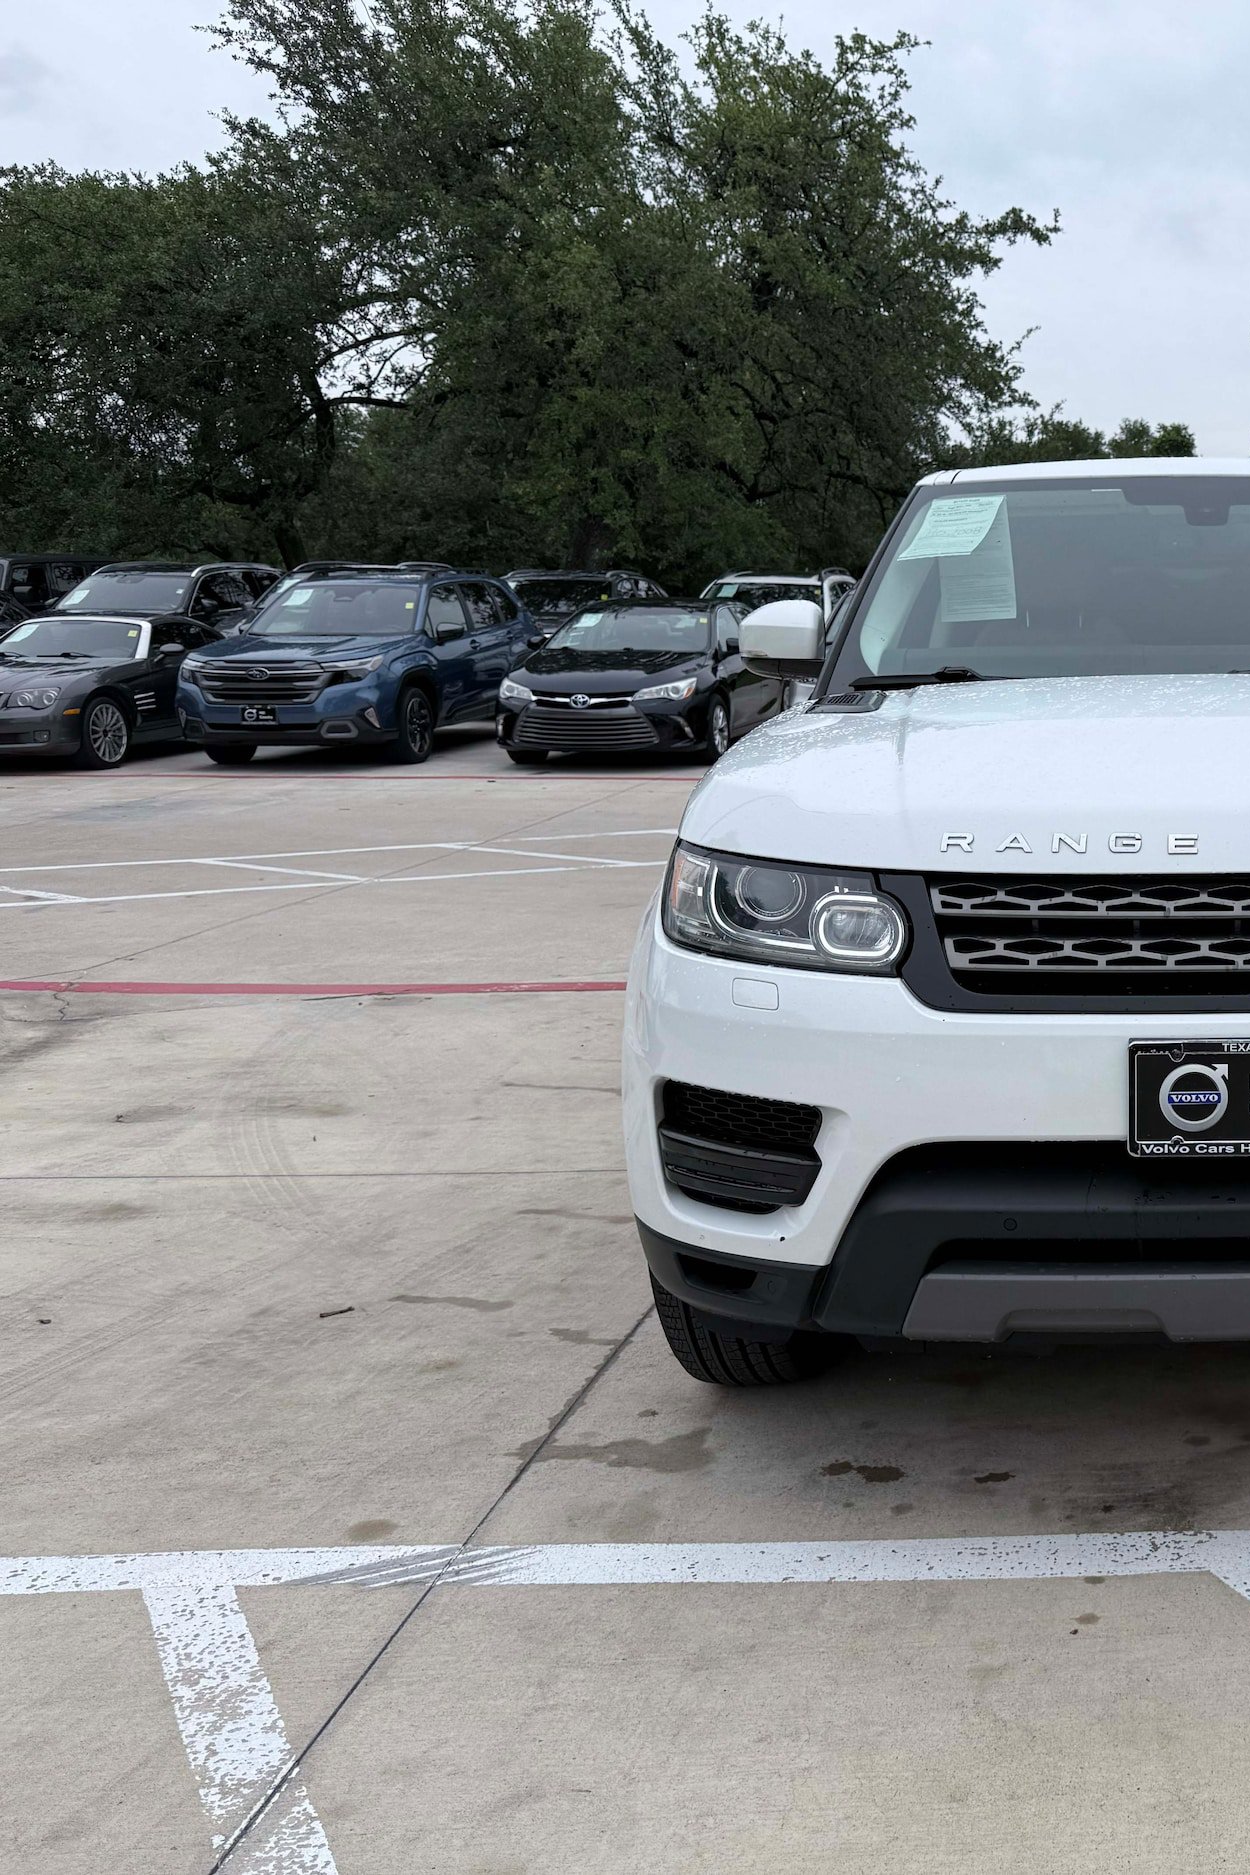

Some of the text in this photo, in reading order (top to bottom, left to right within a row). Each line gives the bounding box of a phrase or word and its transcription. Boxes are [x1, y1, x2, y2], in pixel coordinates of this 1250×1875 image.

[939, 831, 1200, 856] RANGE
[1170, 1093, 1219, 1103] VOLVO
[1141, 1144, 1191, 1155] Volvo
[1194, 1143, 1235, 1154] Cars
